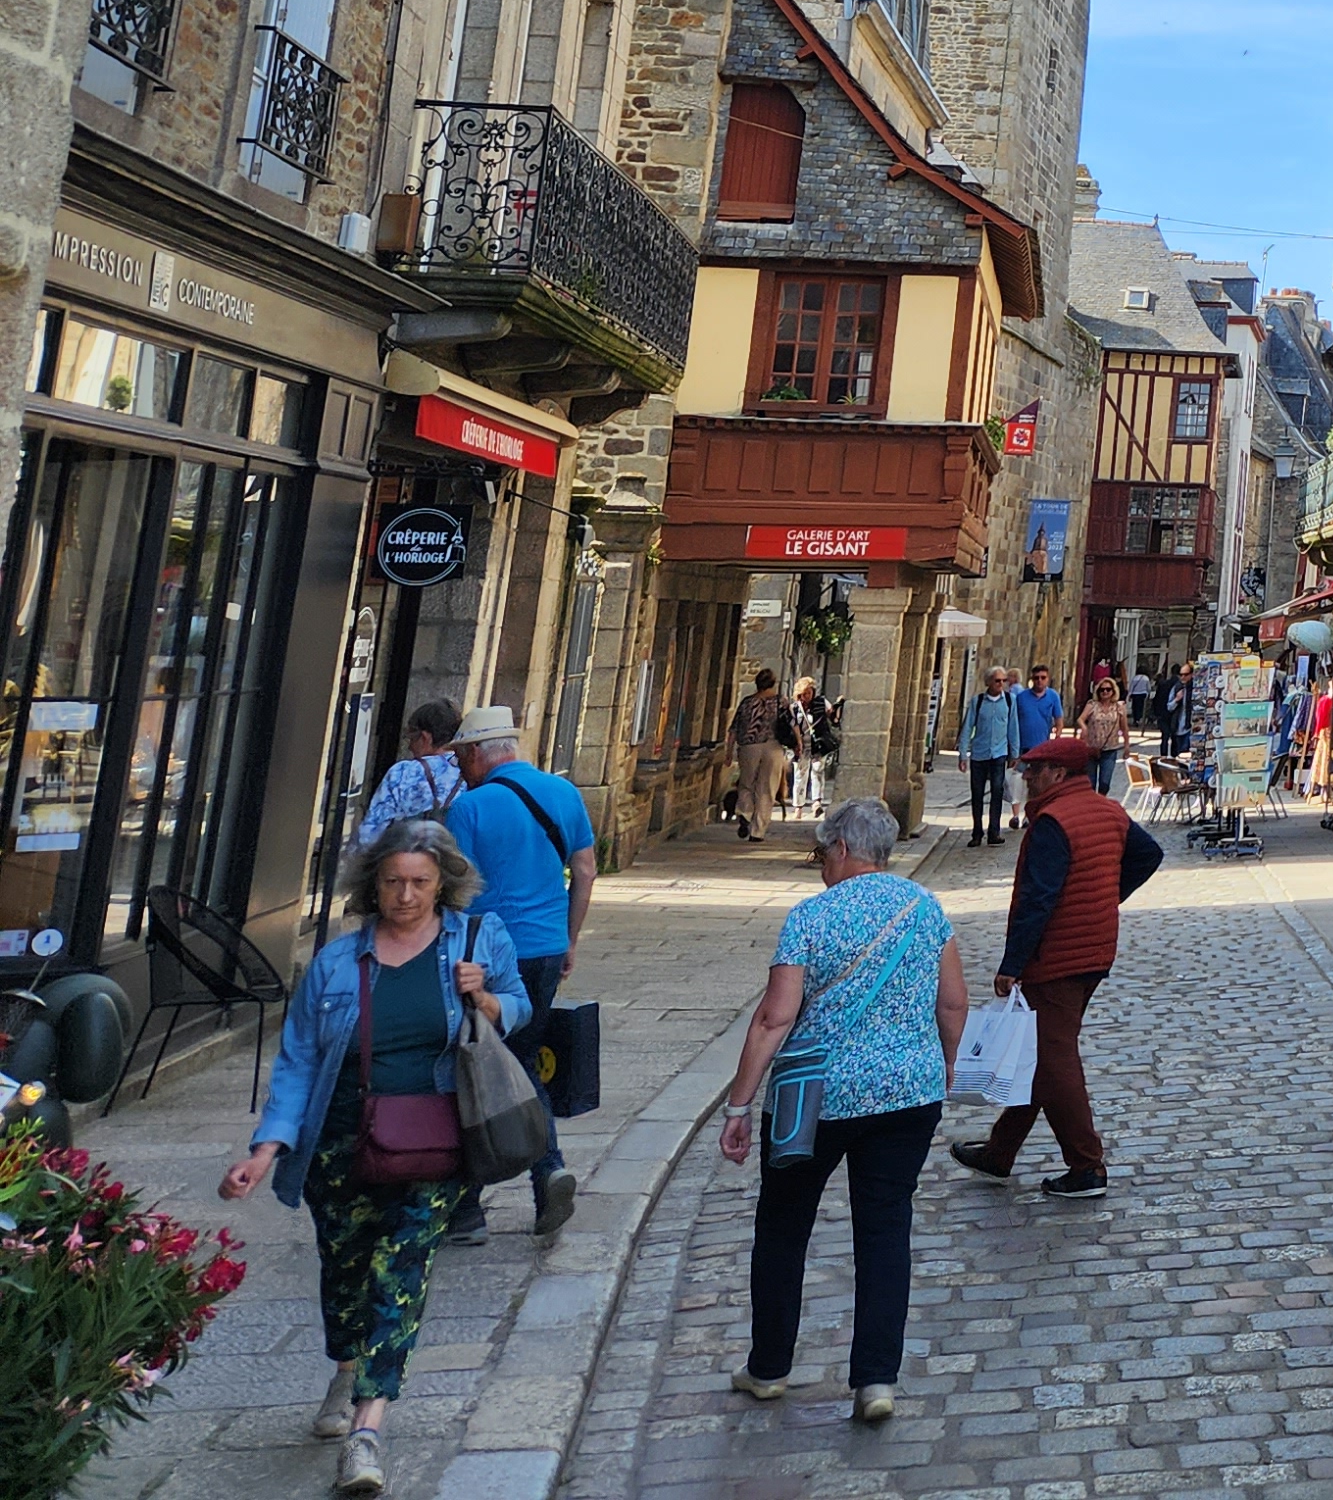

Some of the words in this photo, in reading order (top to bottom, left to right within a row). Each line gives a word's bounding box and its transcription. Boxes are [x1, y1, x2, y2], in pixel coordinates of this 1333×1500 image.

[54, 231, 144, 286] MPRESSION
[177, 278, 255, 325] CONTEMPORAINE
[488, 429, 497, 453] DE
[388, 528, 448, 545] CRÊPERIE
[787, 530, 833, 540] GALERIE
[836, 530, 871, 541] D'ART
[785, 541, 803, 555] LE
[807, 541, 870, 556] GISANT
[385, 552, 445, 563] L'HORLOGE
